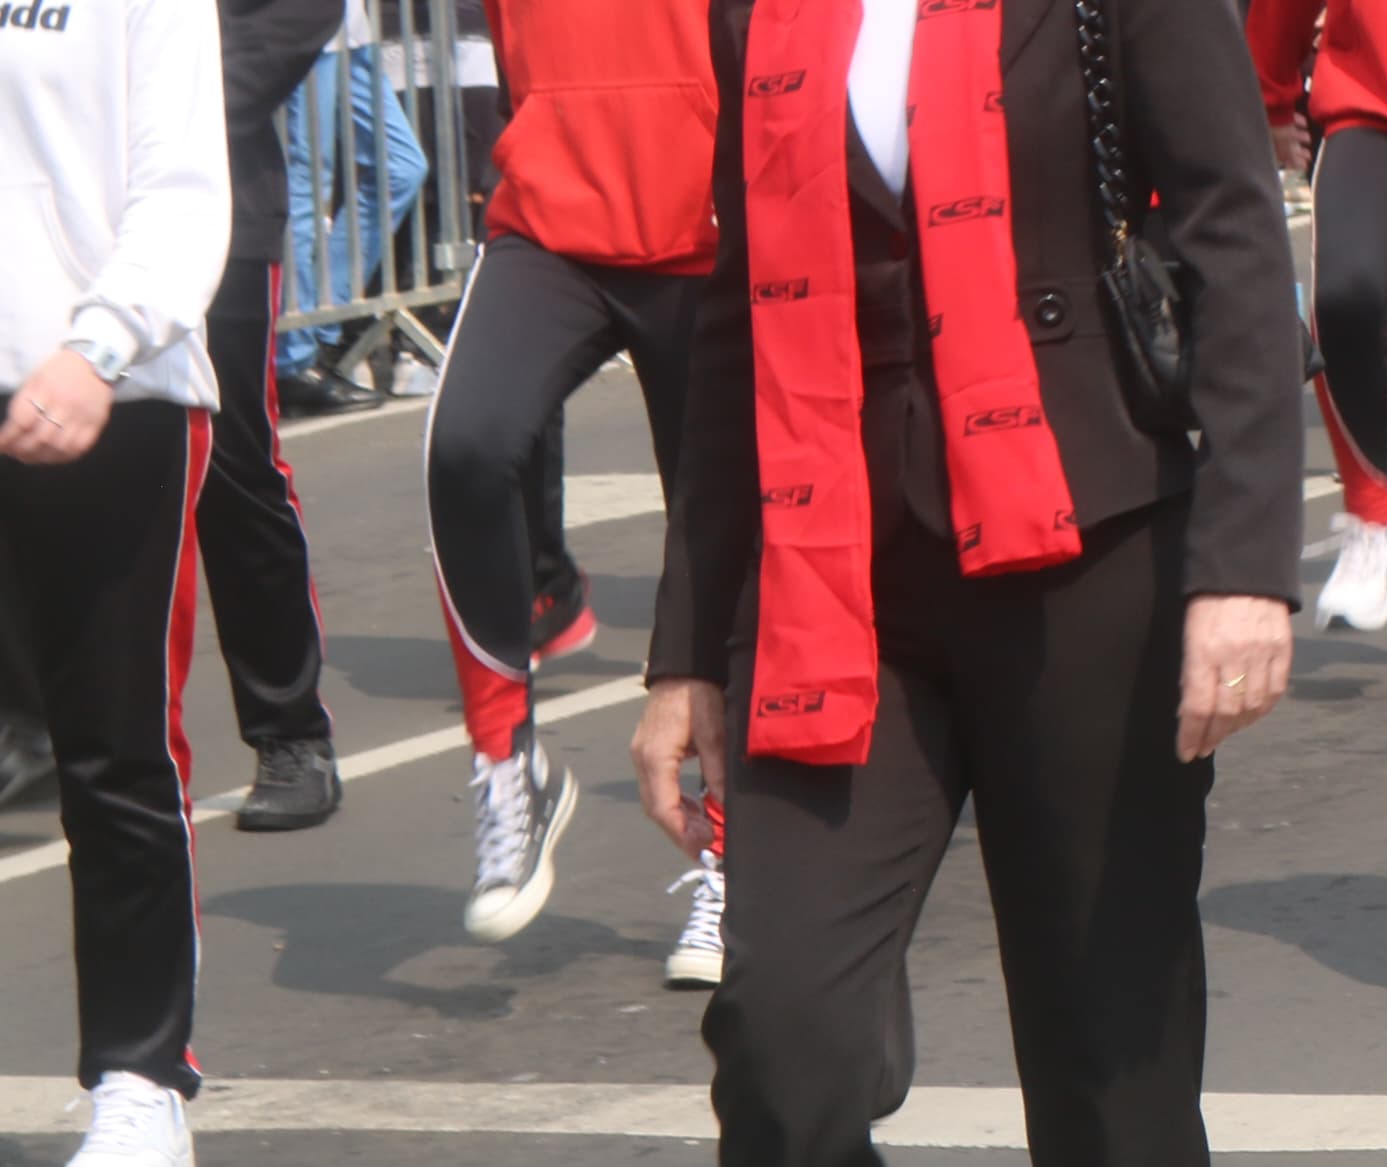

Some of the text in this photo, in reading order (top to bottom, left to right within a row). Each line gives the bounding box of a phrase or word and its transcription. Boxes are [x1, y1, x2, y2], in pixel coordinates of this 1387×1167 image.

[748, 69, 806, 97] CSF
[928, 196, 1004, 227] CSF
[965, 406, 1042, 437] CSF
[757, 690, 825, 717] CSF
